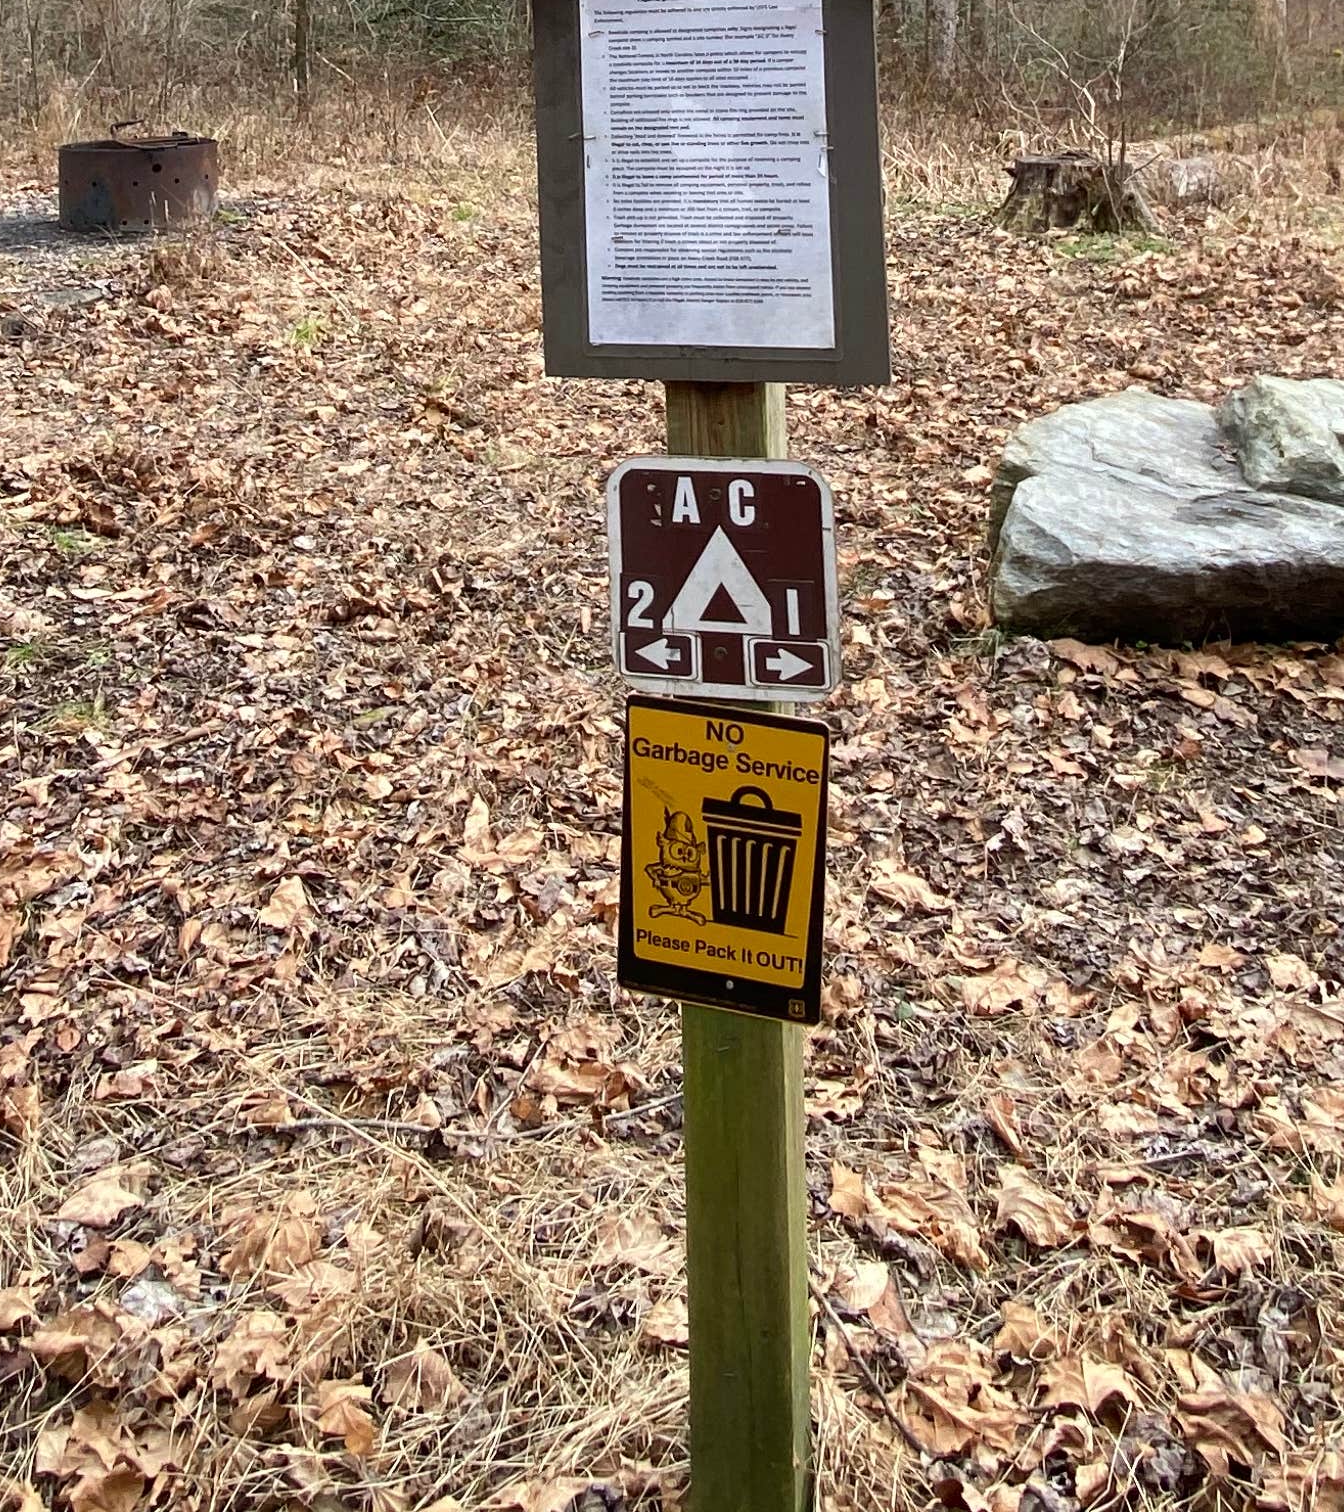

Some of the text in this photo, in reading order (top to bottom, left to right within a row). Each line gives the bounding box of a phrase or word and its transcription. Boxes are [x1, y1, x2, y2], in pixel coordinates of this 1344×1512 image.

[672, 476, 756, 527] A C
[627, 580, 654, 628] 2
[706, 720, 744, 745] NO
[632, 737, 820, 785] Garbage Service
[636, 928, 803, 974] Please Pack It OUT!
